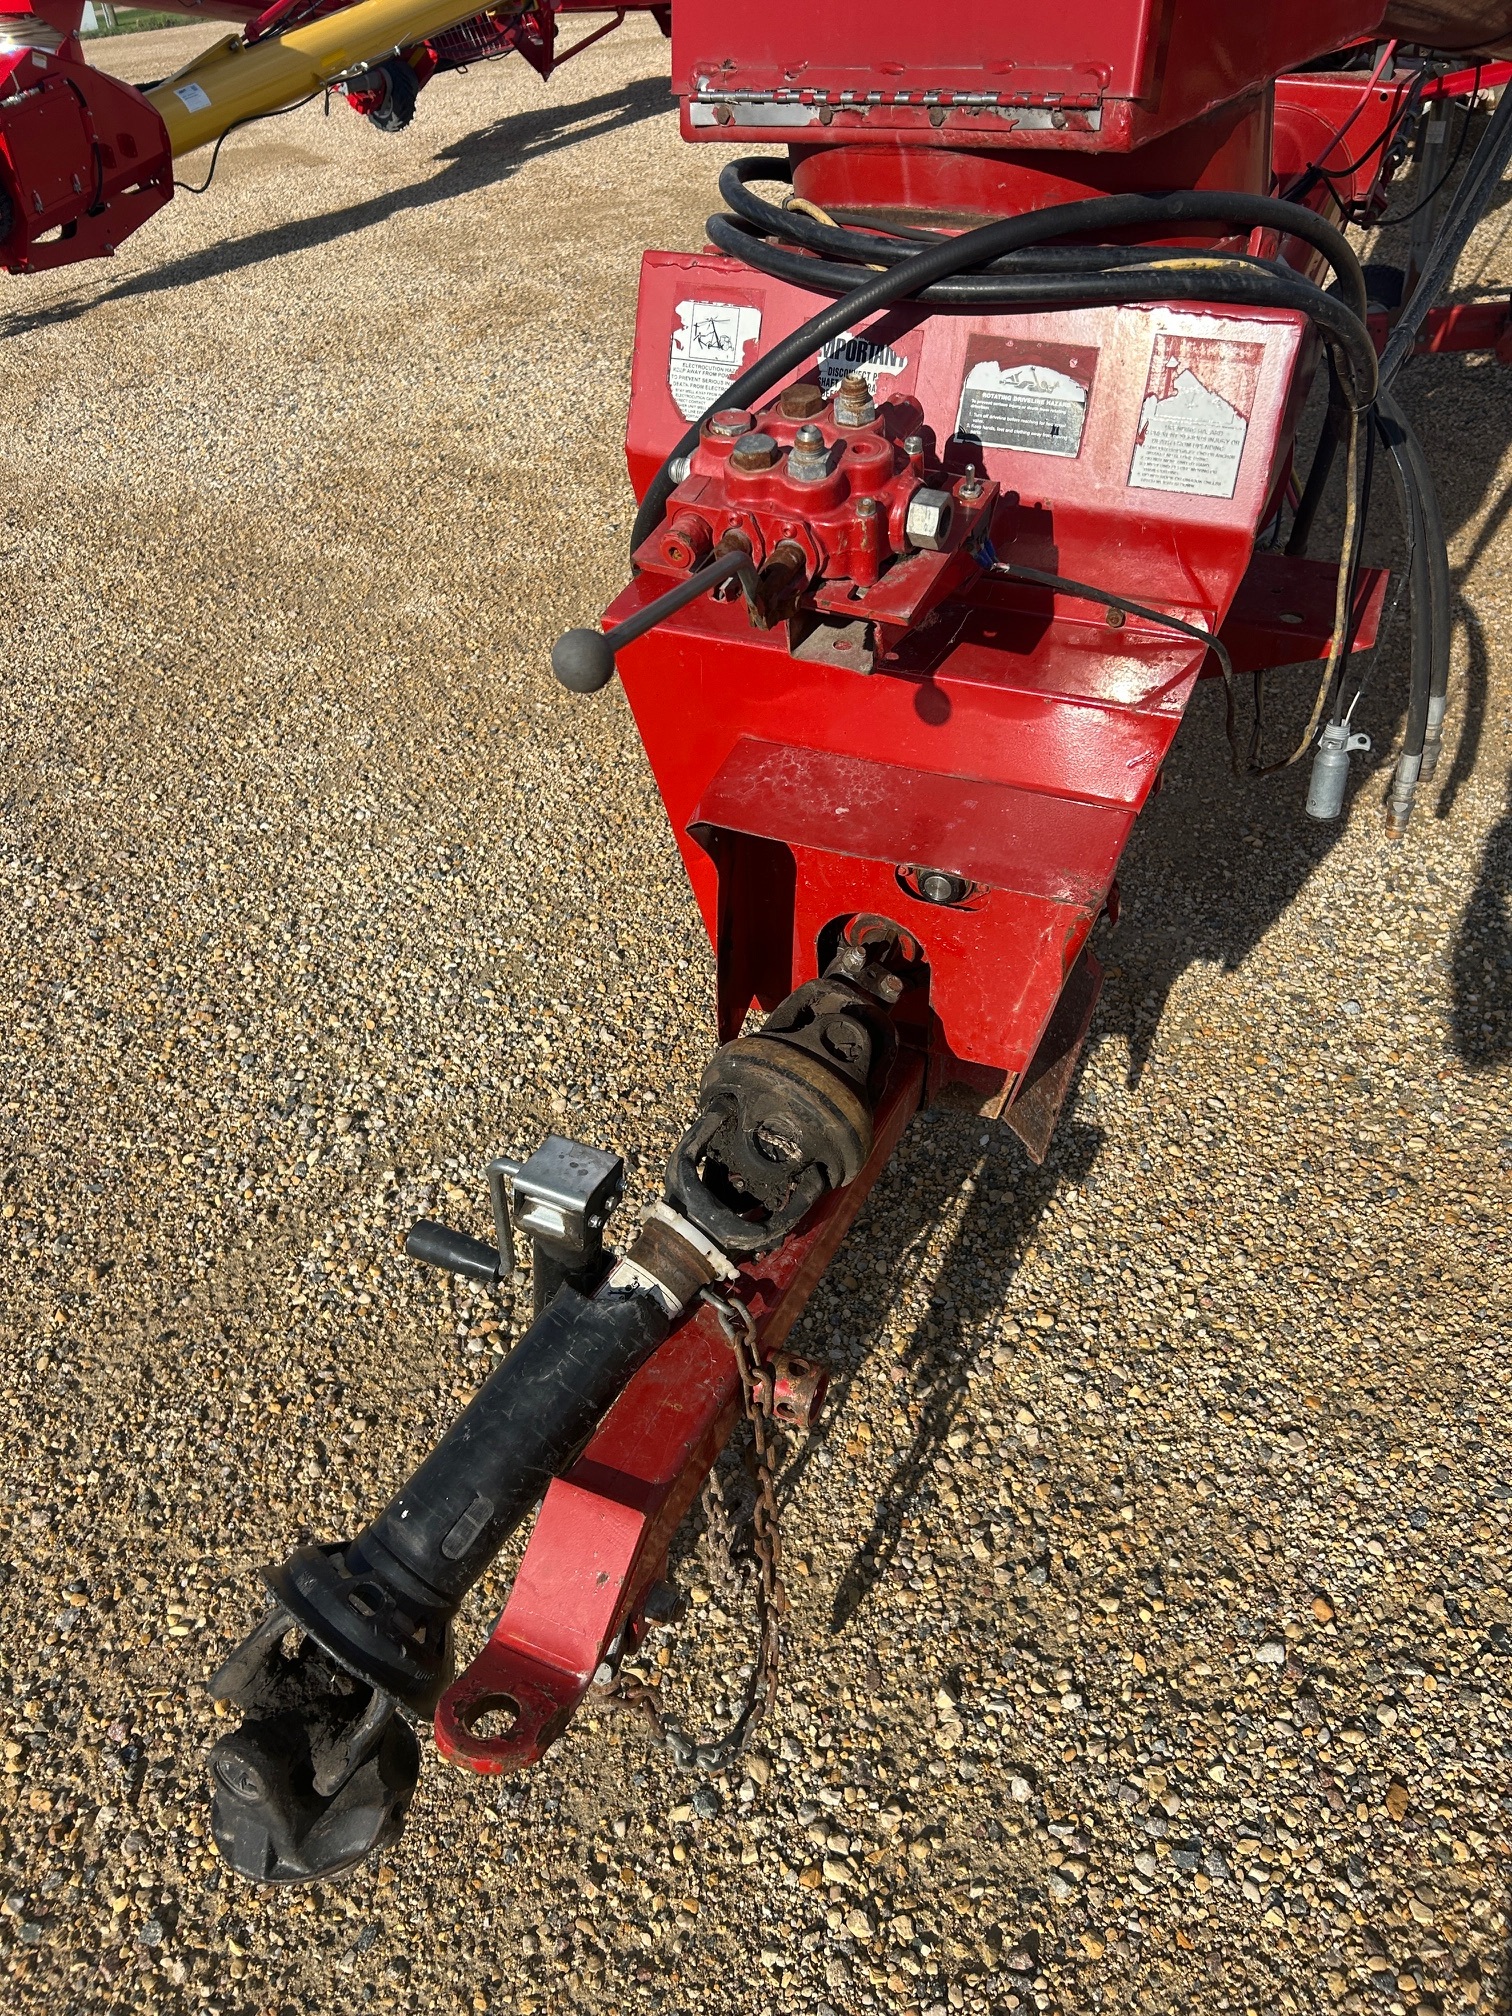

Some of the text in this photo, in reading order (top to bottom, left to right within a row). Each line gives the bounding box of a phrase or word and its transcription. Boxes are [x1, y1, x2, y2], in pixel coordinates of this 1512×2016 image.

[683, 363, 724, 372] ELECTROCUTION
[982, 393, 1012, 401] ROTATING
[1013, 396, 1044, 405] DRIVELINE
